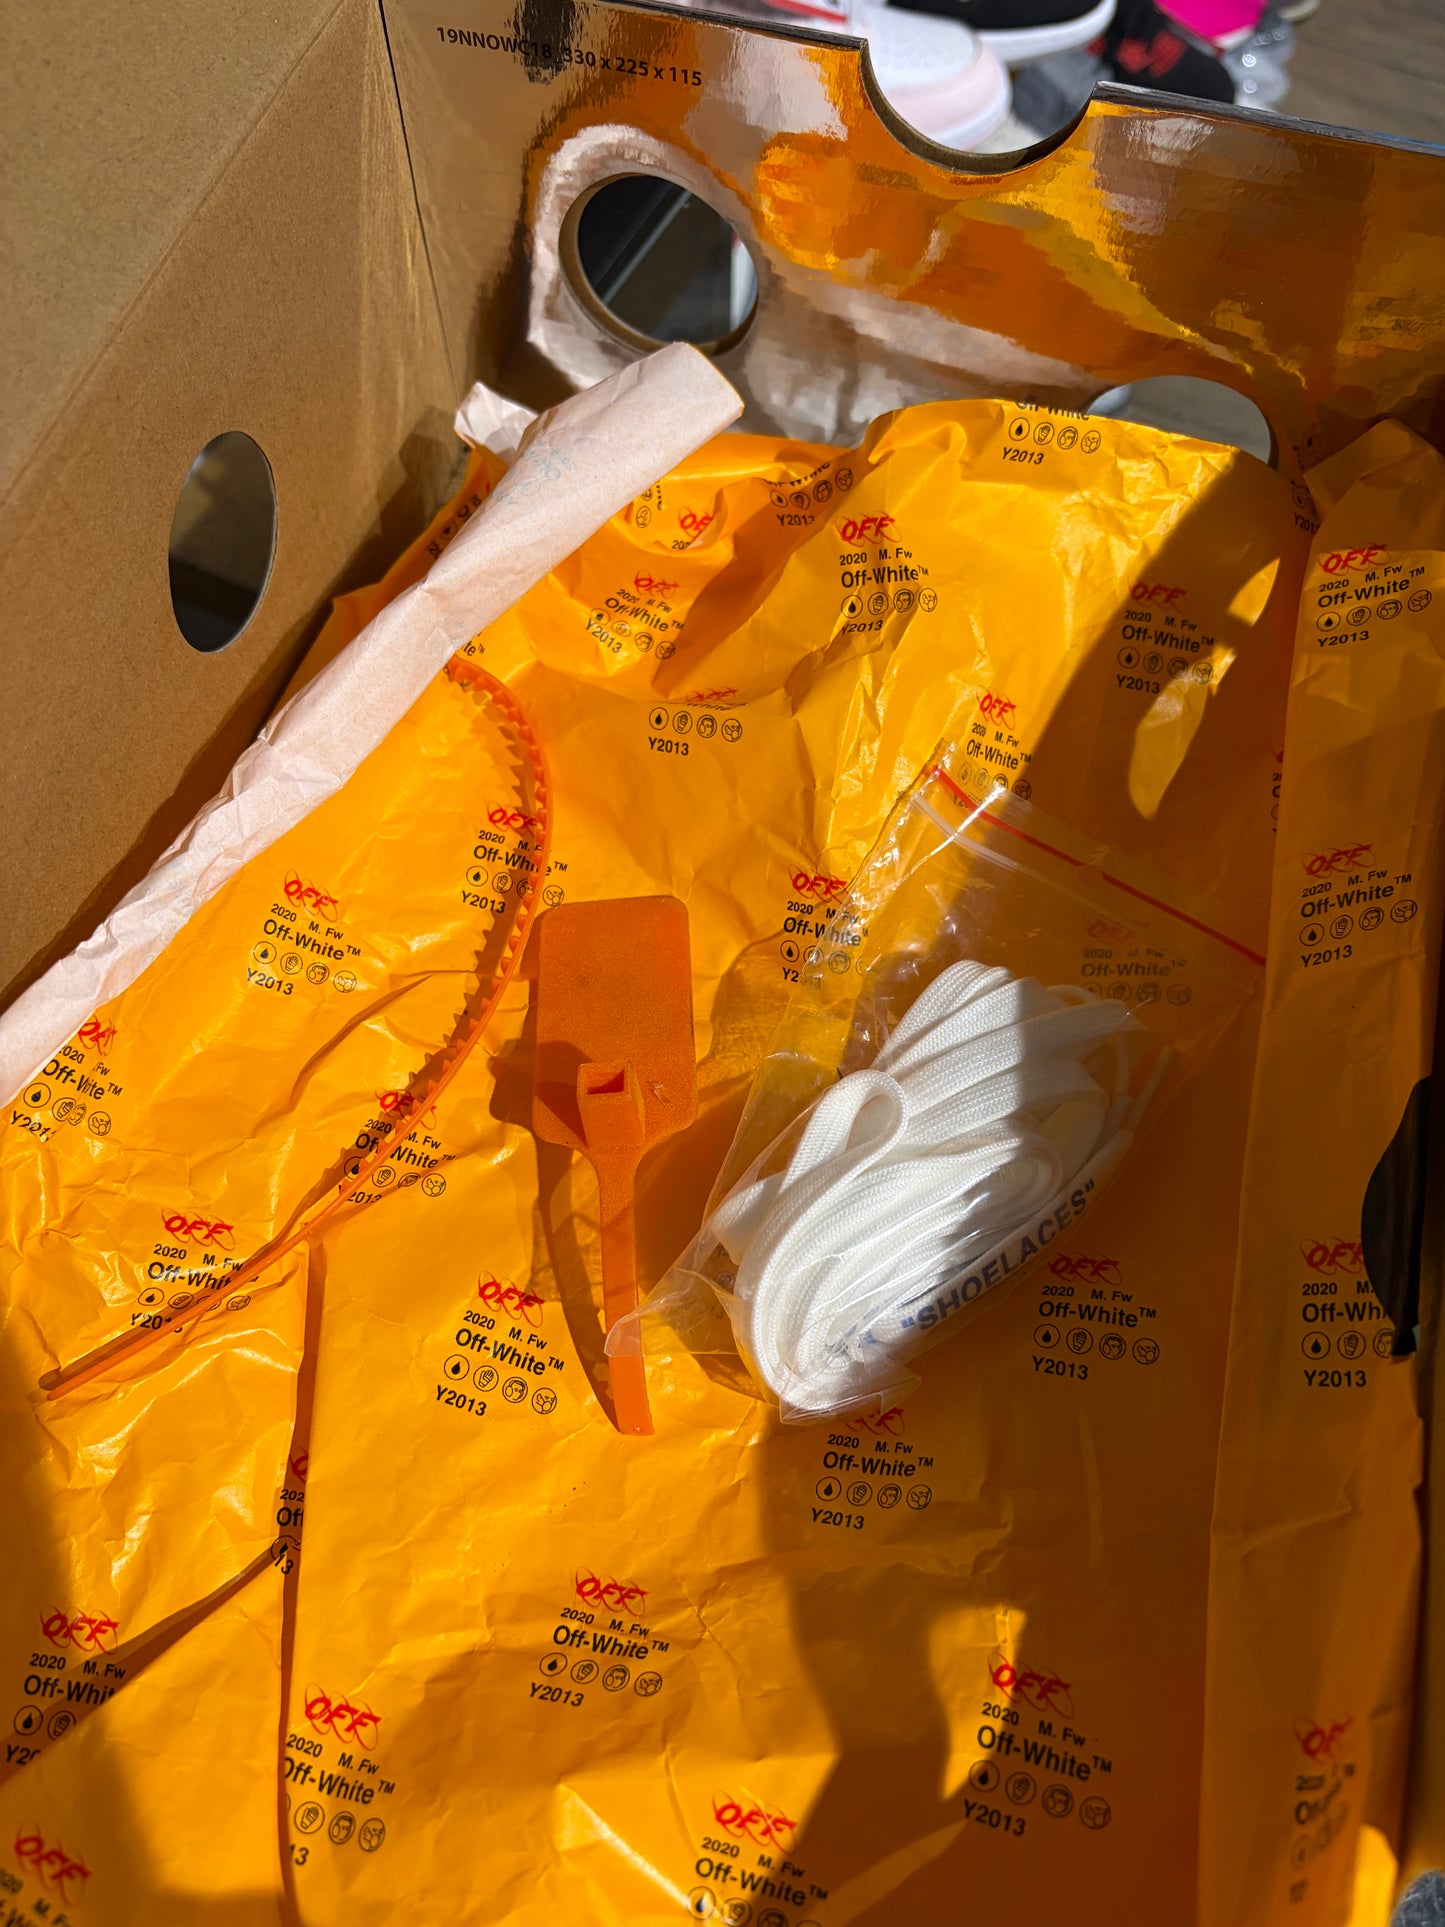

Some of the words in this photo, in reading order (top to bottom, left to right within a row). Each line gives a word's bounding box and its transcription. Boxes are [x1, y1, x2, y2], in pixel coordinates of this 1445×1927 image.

[437, 27, 552, 59] 19NNOWC18
[563, 47, 596, 67] 330
[600, 57, 611, 70] x
[616, 57, 649, 77] 225
[653, 66, 664, 80] x
[669, 66, 702, 86] 115
[1002, 447, 1045, 465] Y2013
[836, 512, 898, 545] OFF
[840, 552, 868, 566] 2020
[896, 547, 913, 560] Fw
[1320, 543, 1390, 575] OFF
[1319, 579, 1349, 592] 2020
[1384, 564, 1403, 577] Fw
[1129, 579, 1188, 609] OFF
[1124, 610, 1152, 622] 2020
[1181, 620, 1198, 631] Fw
[586, 618, 623, 653] Y2013
[1318, 630, 1370, 647] Y2013
[1116, 674, 1160, 694] Y2013
[976, 690, 1017, 726] OFF
[648, 736, 689, 756] Y2013
[1006, 735, 1019, 747] Fw
[488, 804, 536, 831] OFF
[479, 830, 506, 844] 2020
[1303, 843, 1376, 877] OFF
[284, 873, 338, 916] OFF
[790, 868, 848, 902] OFF
[1302, 882, 1332, 897] 2020
[1368, 869, 1388, 882] Fw
[462, 890, 506, 914] Y2013
[787, 901, 814, 914] 2020
[271, 903, 297, 922] 2020
[326, 927, 344, 940] Fw
[1301, 945, 1353, 968] Y2013
[247, 967, 294, 995] Y2013
[58, 1046, 85, 1064] 020
[365, 1119, 392, 1134] 2020
[423, 1136, 441, 1149] Fw
[163, 1211, 235, 1248] OFF
[154, 1244, 187, 1260] 2020
[223, 1258, 243, 1272] Fw
[1049, 1254, 1121, 1283] OFF
[478, 1276, 544, 1322] OFF
[1042, 1286, 1074, 1297] 2020
[1112, 1291, 1133, 1302] Fw
[1302, 1282, 1338, 1295] 2020
[463, 1310, 495, 1330] 2020
[527, 1333, 548, 1349] Fw
[1032, 1355, 1089, 1380] Y2013
[1304, 1370, 1367, 1387] Y2013
[436, 1384, 487, 1416] Y2013
[827, 1434, 860, 1449] 2020
[894, 1442, 913, 1454] Fw
[280, 1488, 305, 1502] 202
[811, 1508, 865, 1529] Y2013
[576, 1572, 648, 1613] OFF
[41, 1608, 119, 1650] OFF
[560, 1608, 595, 1625] 2020
[629, 1623, 649, 1637] Fw
[29, 1653, 66, 1670] 2020
[105, 1663, 126, 1679] Fw
[530, 1682, 584, 1707] Y2013
[990, 1658, 1073, 1712] OFF
[304, 1690, 382, 1742] OFF
[981, 1702, 1020, 1725] 2020
[1062, 1727, 1087, 1747] Fw
[286, 1734, 323, 1758] 2020
[358, 1759, 381, 1775] Fw
[713, 1797, 798, 1850] OFF
[963, 1799, 1026, 1836] Y2013
[701, 1837, 740, 1858] 2020
[781, 1860, 805, 1878] Fw
